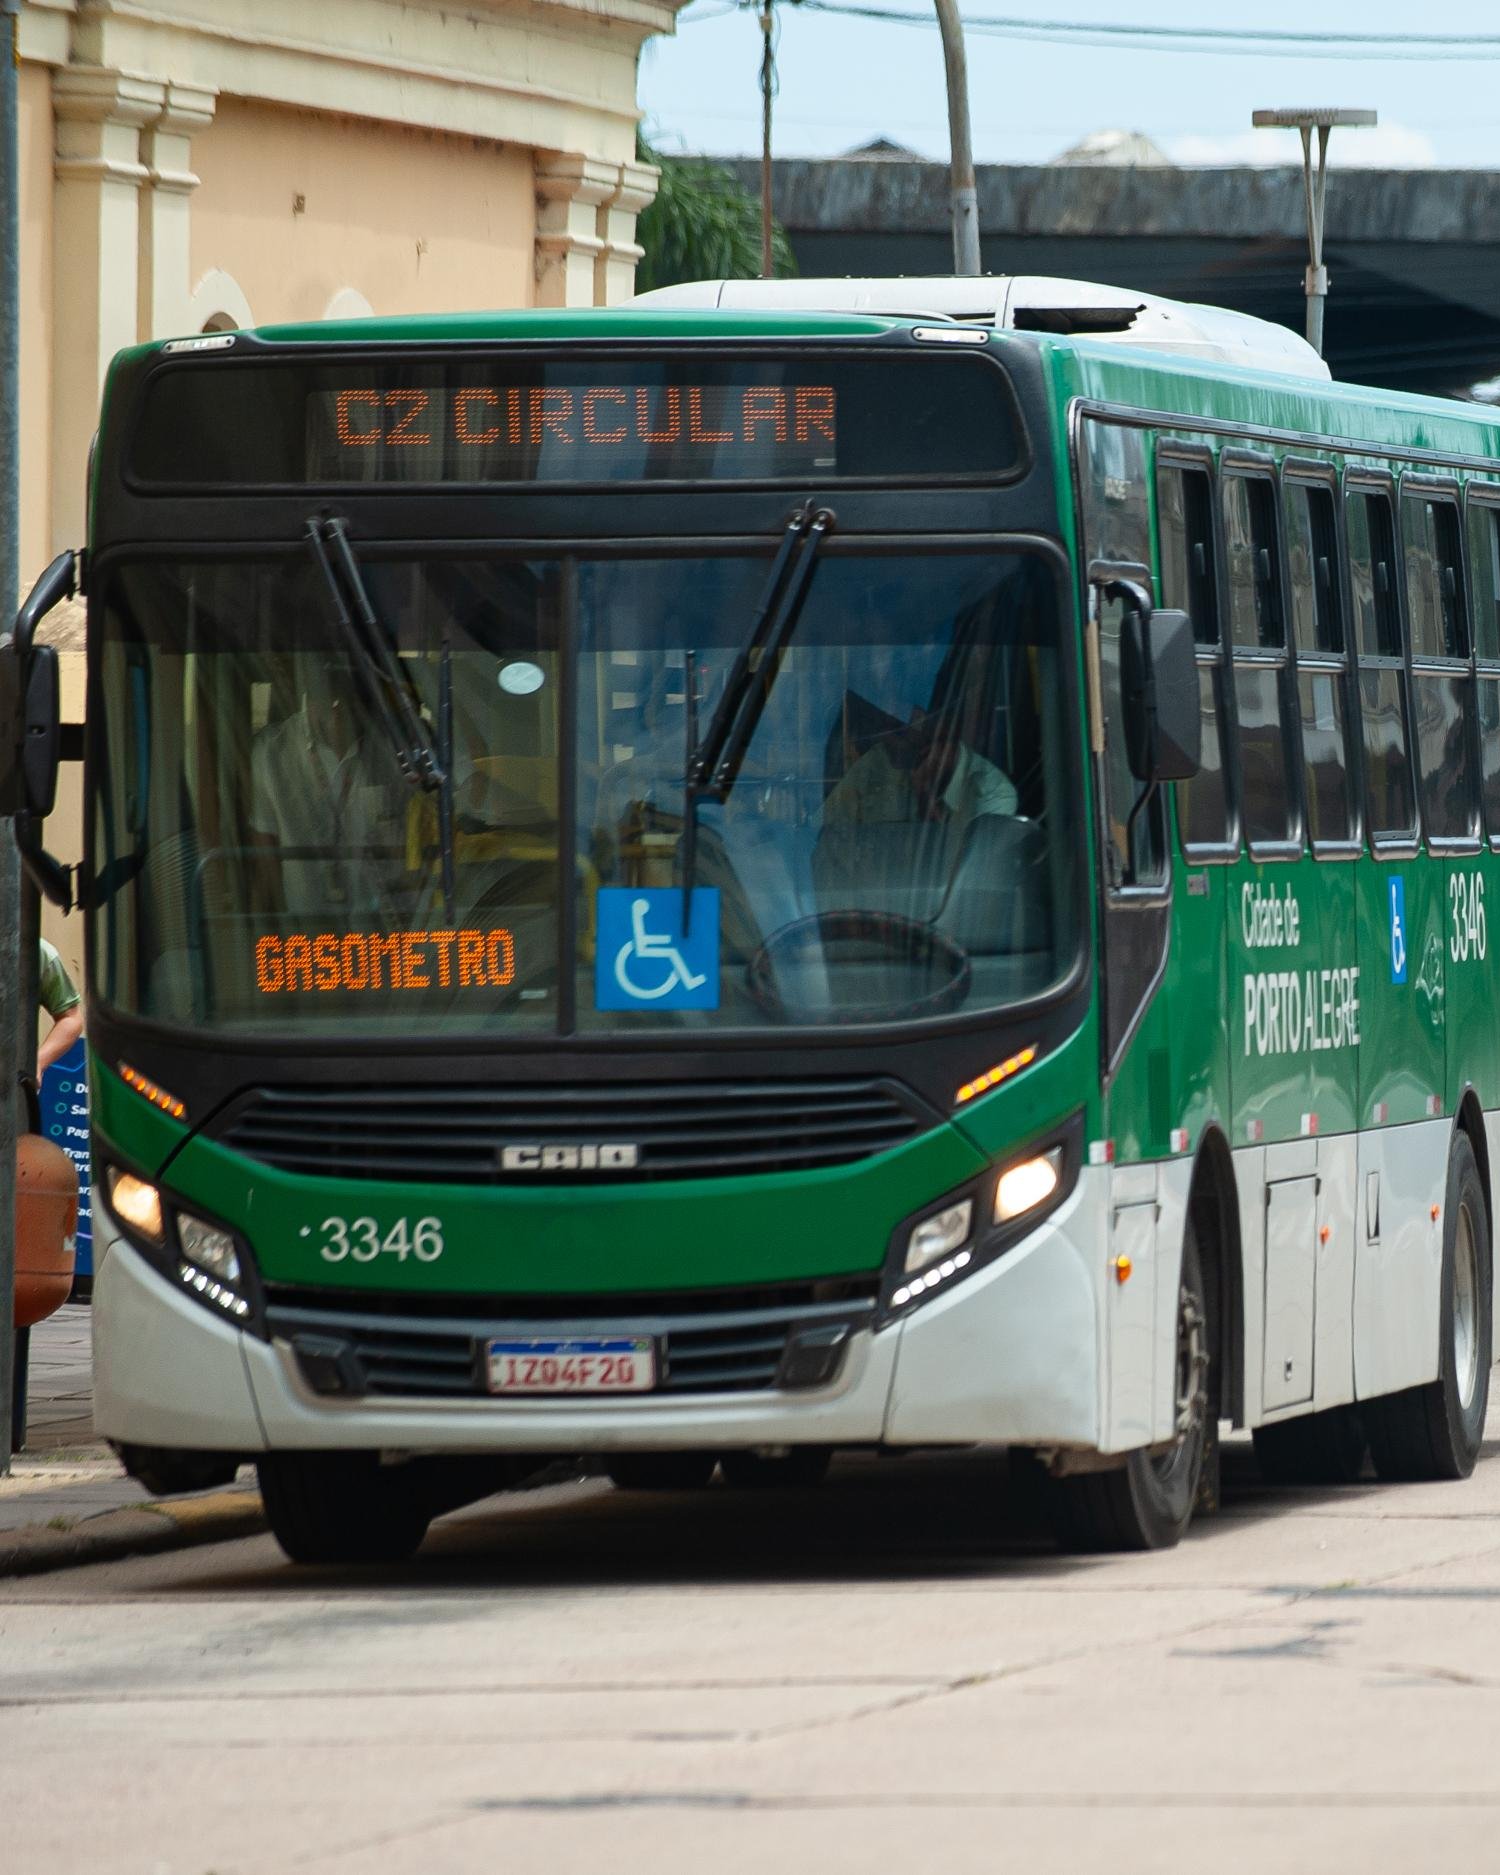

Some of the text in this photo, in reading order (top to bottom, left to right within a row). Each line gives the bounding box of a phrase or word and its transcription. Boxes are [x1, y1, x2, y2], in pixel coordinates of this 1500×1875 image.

[337, 386, 837, 446] C2 CIRCULAR
[1242, 881, 1300, 948] Cidade de
[1449, 871, 1486, 963] 3346
[255, 928, 515, 993] GASOMETRO
[1244, 966, 1360, 1057] PORTO ALEGRE
[320, 1216, 444, 1262] 3346
